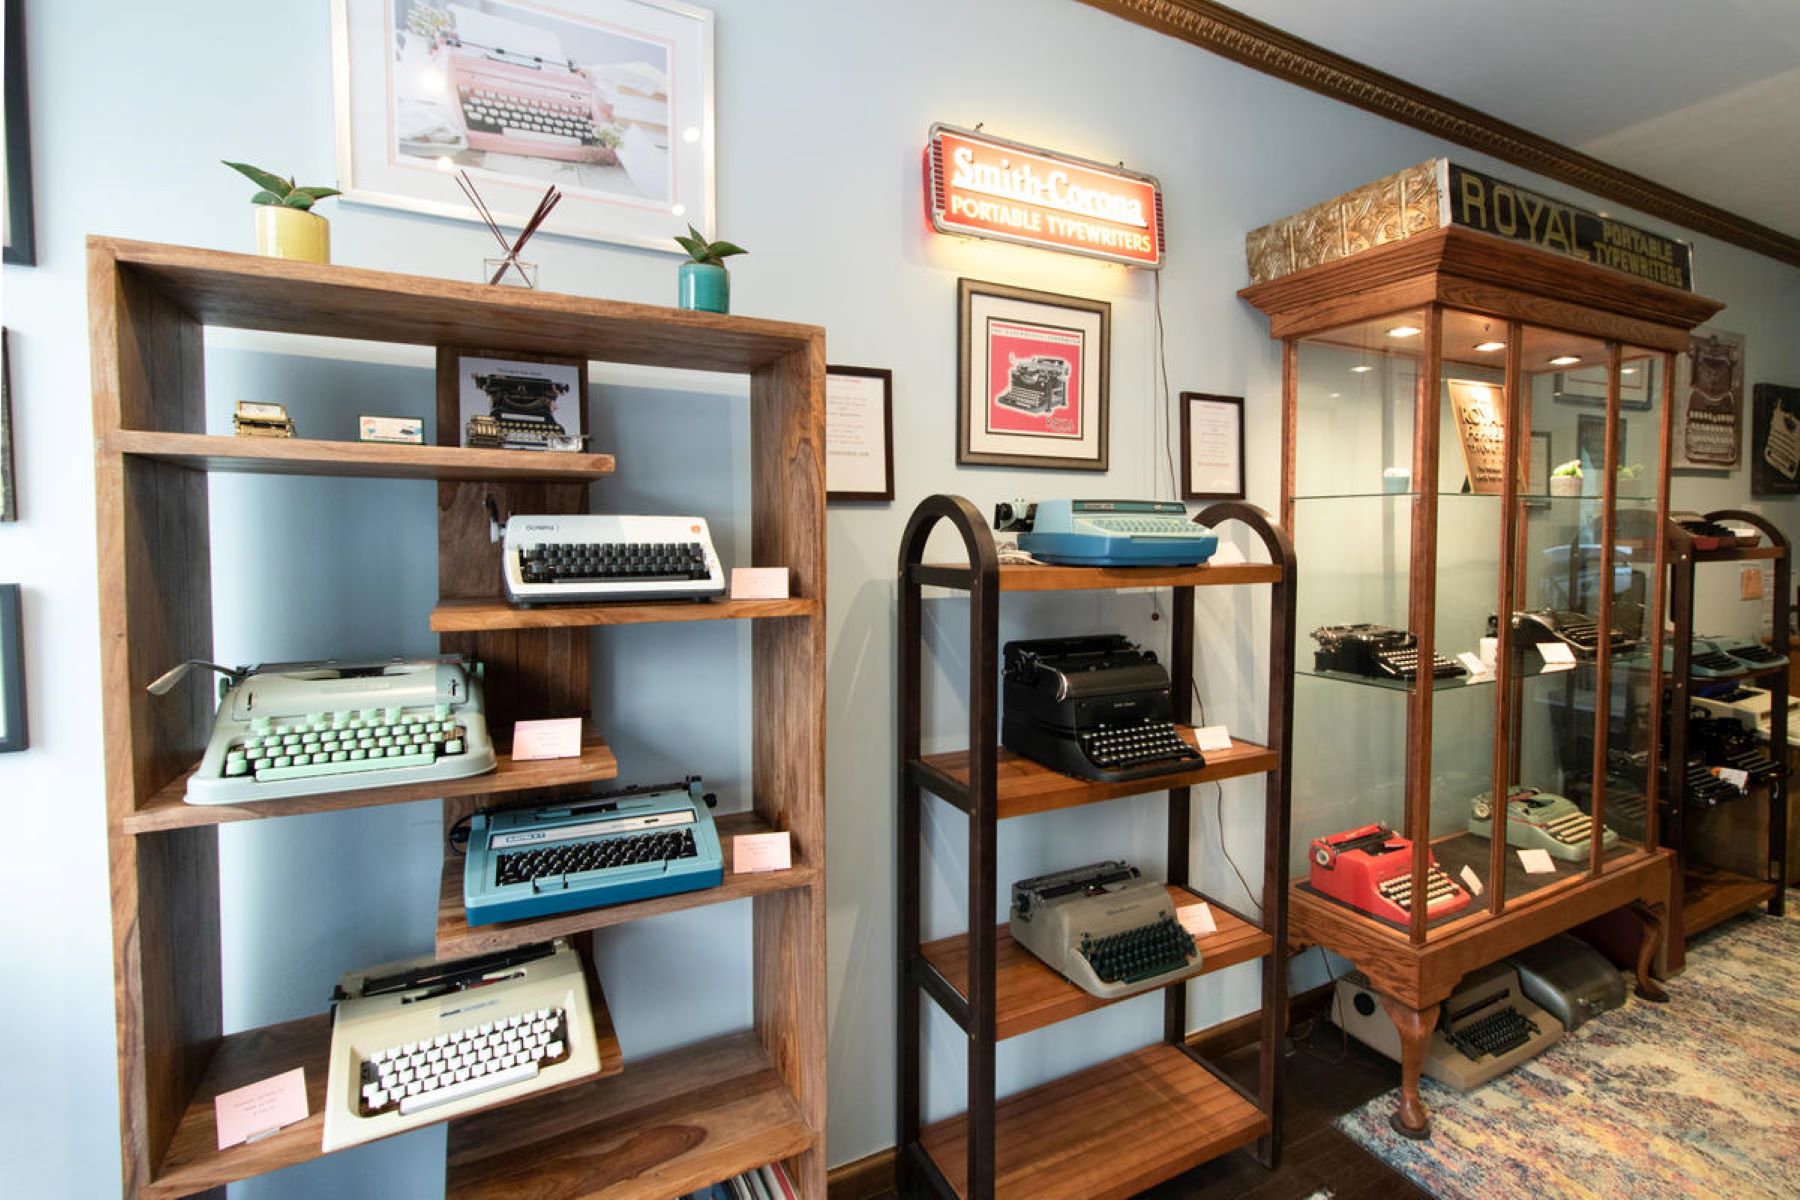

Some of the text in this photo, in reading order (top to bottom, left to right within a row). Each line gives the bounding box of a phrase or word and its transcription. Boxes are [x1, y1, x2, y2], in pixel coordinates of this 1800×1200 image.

[952, 147, 1143, 220] Smith-Corona
[951, 194, 1151, 252] PORTABLE TYPEWRITERS
[1460, 172, 1590, 262] ROYAL
[1602, 221, 1673, 263] PORTABLE
[1593, 241, 1683, 288] TYPEWRITERS
